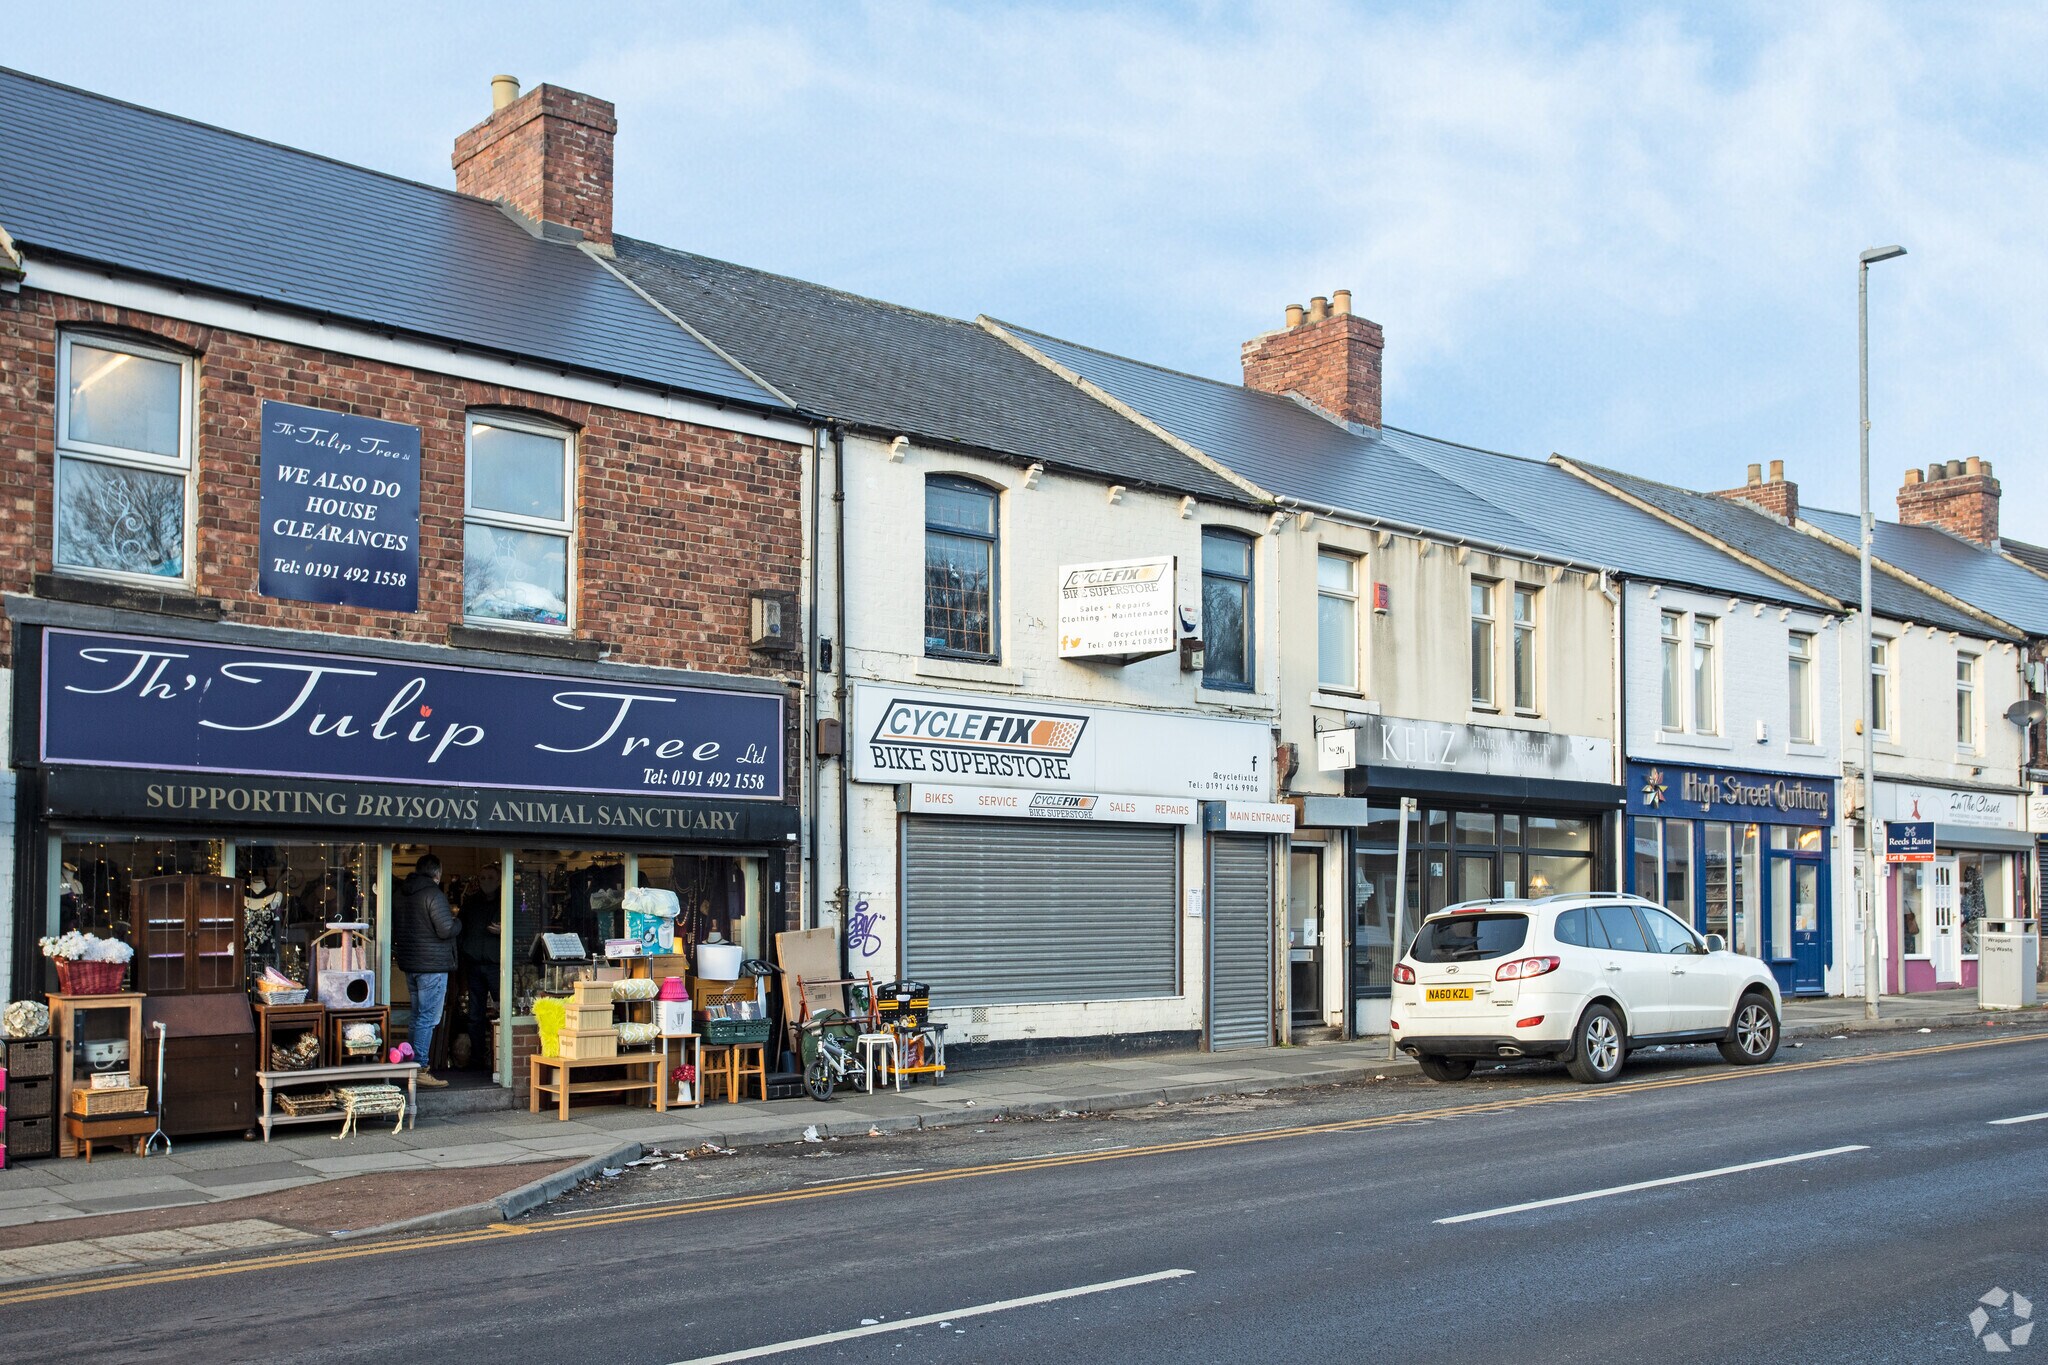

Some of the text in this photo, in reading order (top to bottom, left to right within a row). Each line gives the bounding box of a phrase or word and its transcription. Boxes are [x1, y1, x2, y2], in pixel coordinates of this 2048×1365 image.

[296, 426, 351, 454] Tulip
[357, 437, 400, 459] Tree
[278, 464, 401, 498] WE ALSO DO
[305, 496, 378, 521] HOUSE
[273, 519, 408, 551] CLEARANCES
[274, 558, 406, 587] Tel: 0191 492 1558
[1071, 568, 1140, 586] CYCLEFIX
[1090, 583, 1158, 598] SUPERSTORE
[1062, 609, 1169, 623] Clothing Maintenance
[1116, 602, 1151, 610] Repairs
[198, 662, 485, 763] Tulip
[534, 692, 720, 761] Tree
[736, 743, 765, 764] Ltd
[890, 707, 1036, 744] CYCLEFIX
[1380, 724, 1457, 766] KELZ
[870, 746, 1070, 780] BIKE SUPERSTORE
[643, 768, 765, 790] Tel: 0191 492 1558
[1213, 772, 1258, 782] @cyclefixltd
[925, 792, 1017, 807] BIKES SERVICE
[1034, 796, 1081, 806] CYCLEFIX
[1682, 772, 1828, 819] High Street Quilting
[1950, 793, 2000, 813] In The Closet
[146, 784, 739, 832] SUPPORTING BRYSONS ANIMAL SANCTUARY
[1047, 810, 1093, 819] SUPERSTORE
[1109, 802, 1189, 815] SALES REPAIRS
[1230, 812, 1290, 823] MAIN ENTRANCE
[1429, 988, 1469, 999] NA60 KZL
